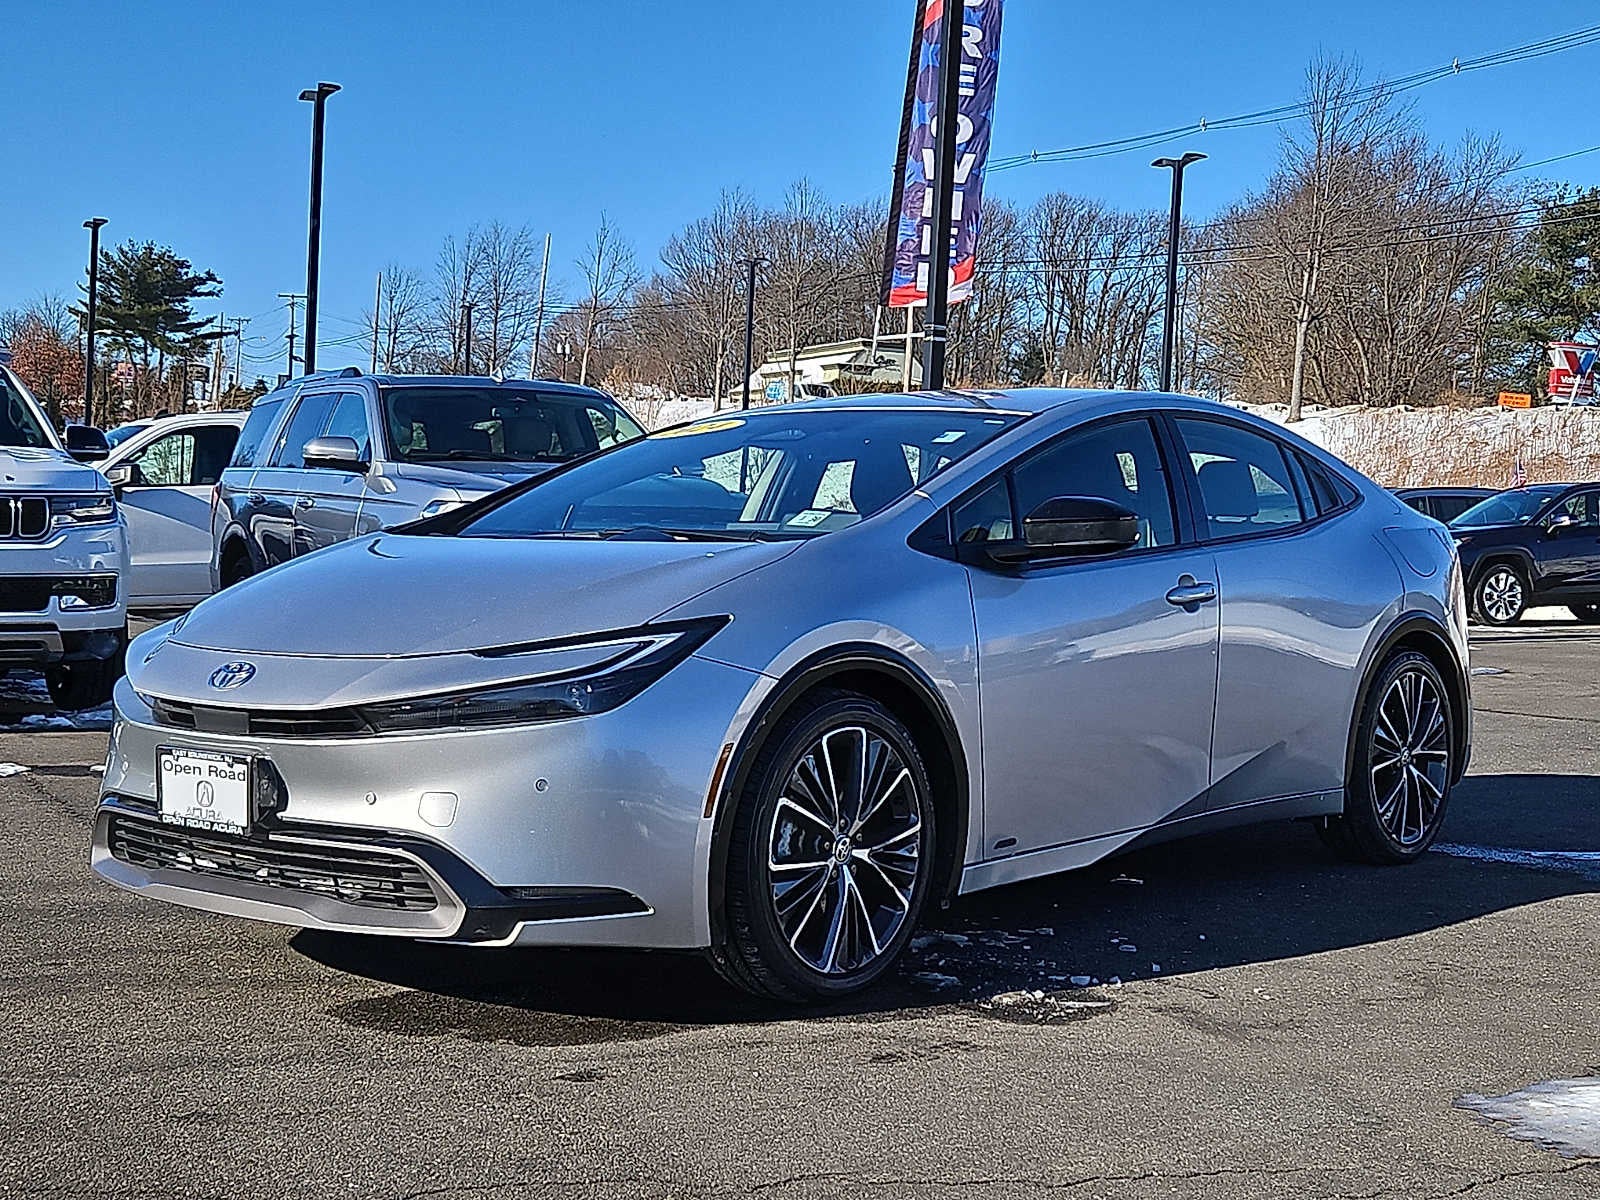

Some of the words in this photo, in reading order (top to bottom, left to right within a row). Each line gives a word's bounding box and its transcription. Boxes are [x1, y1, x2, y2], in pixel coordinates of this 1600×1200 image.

[959, 0, 983, 96] RE
[163, 760, 201, 776] Open
[208, 765, 246, 781] Road
[162, 814, 184, 826] OPEN
[187, 819, 211, 830] ROAD
[212, 824, 243, 835] ACURA
